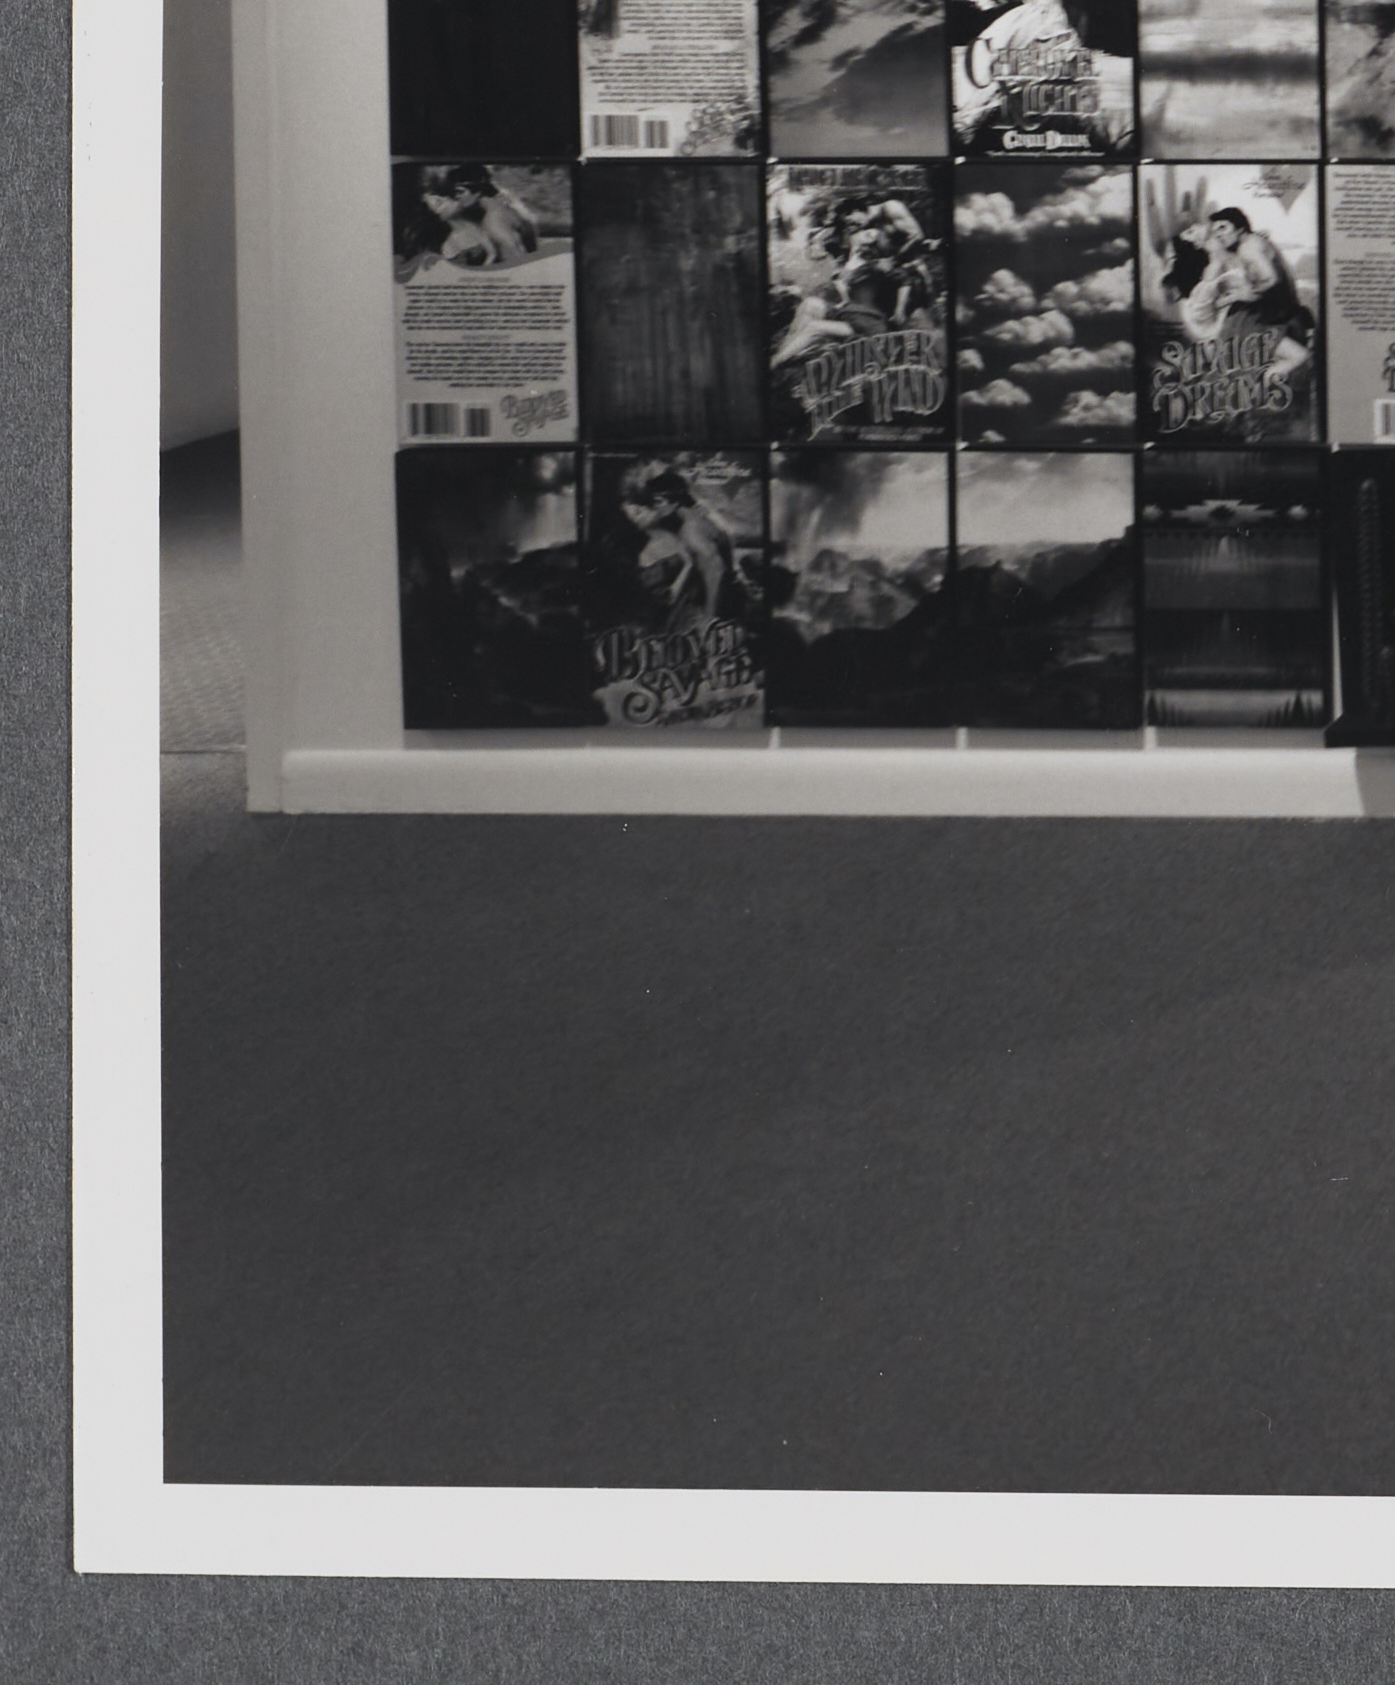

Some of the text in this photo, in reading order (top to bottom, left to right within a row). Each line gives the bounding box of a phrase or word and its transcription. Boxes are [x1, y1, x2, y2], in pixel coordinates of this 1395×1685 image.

[1153, 327, 1279, 387] SAVAGE
[1153, 373, 1293, 434] DREAMS
[596, 617, 748, 684] BELOVED
[621, 652, 751, 726] SAVAGE
